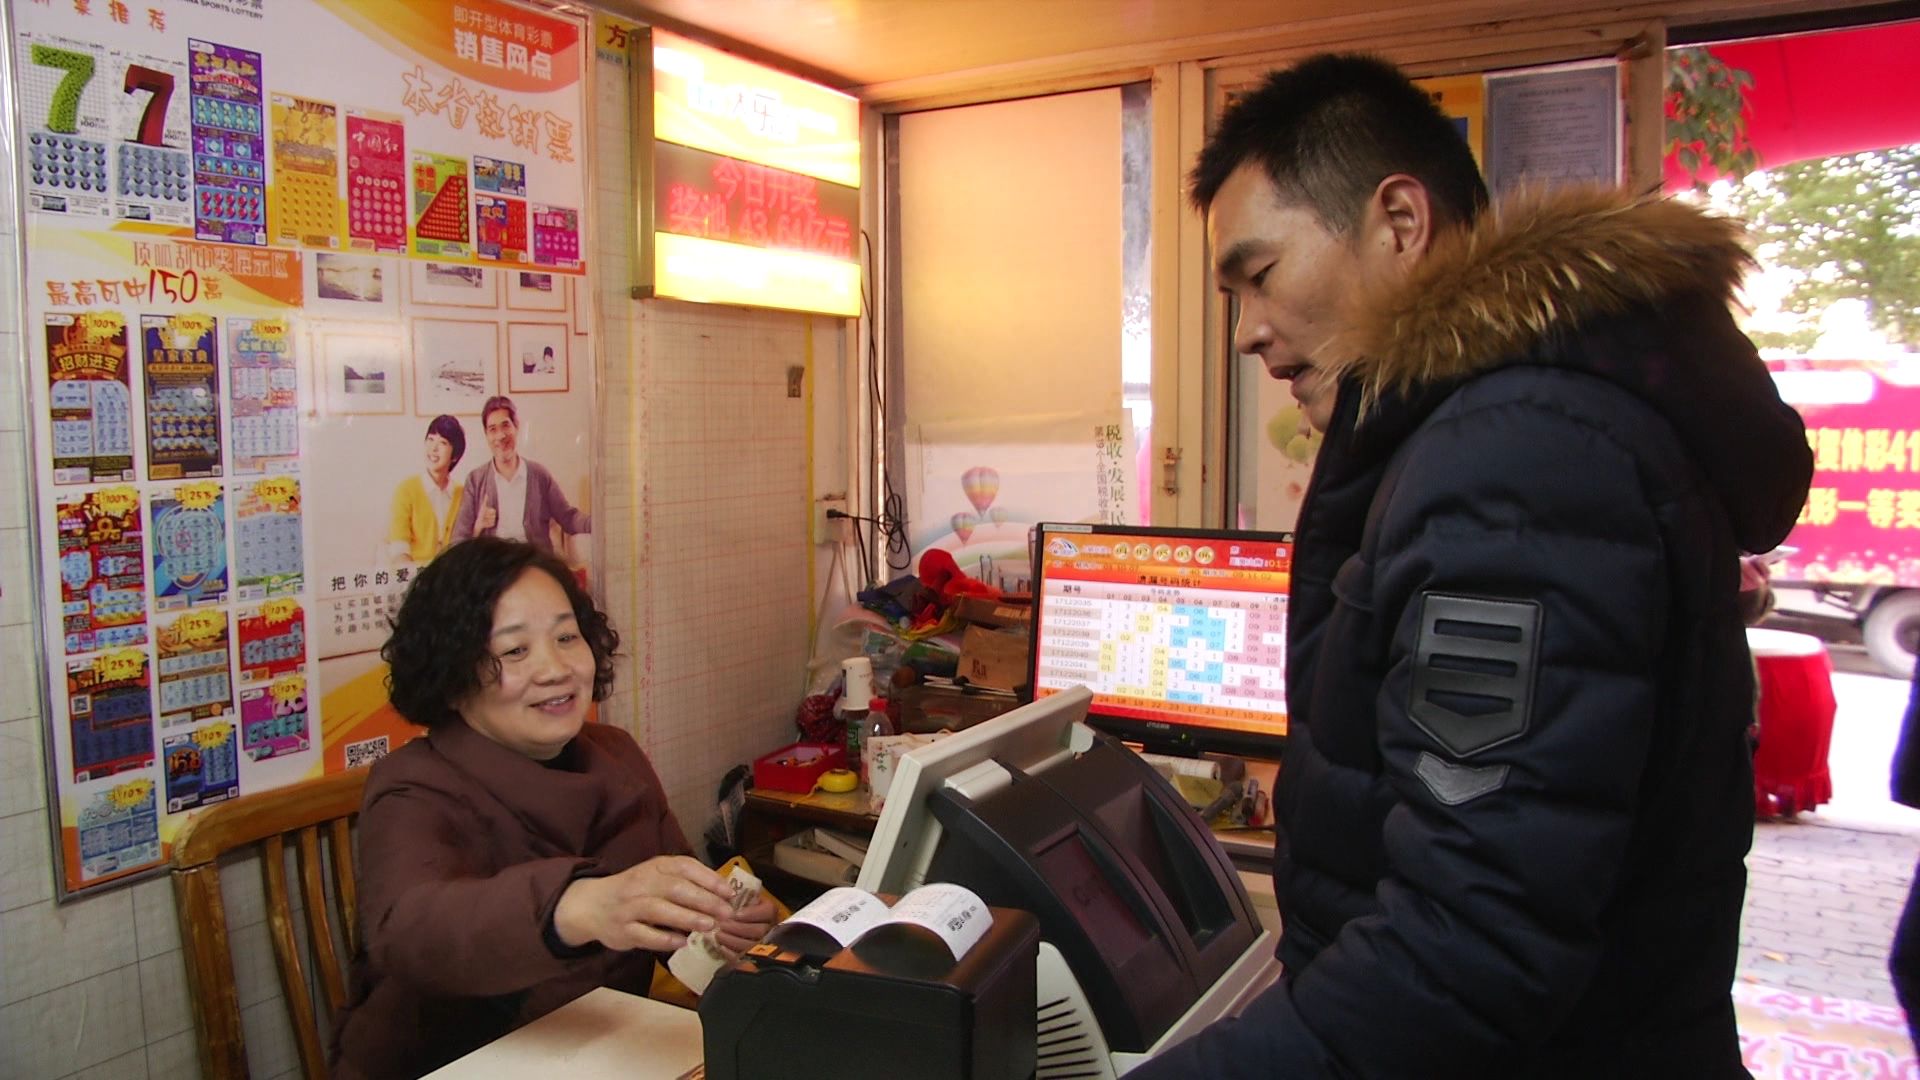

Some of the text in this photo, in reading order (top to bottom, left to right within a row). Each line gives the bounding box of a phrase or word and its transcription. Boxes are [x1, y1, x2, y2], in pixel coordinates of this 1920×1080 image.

[231, 8, 264, 19] LOTTERY
[454, 5, 553, 49] 即开型体育彩票
[454, 27, 552, 80] 销售网点
[604, 24, 629, 48] 方
[713, 157, 818, 214] 今日开奖
[133, 241, 289, 279] 顶呱刮中奖展示区
[58, 353, 119, 373] 招财进宝
[1797, 487, 1920, 528] 彩一等奖
[1063, 584, 1081, 594] 期号
